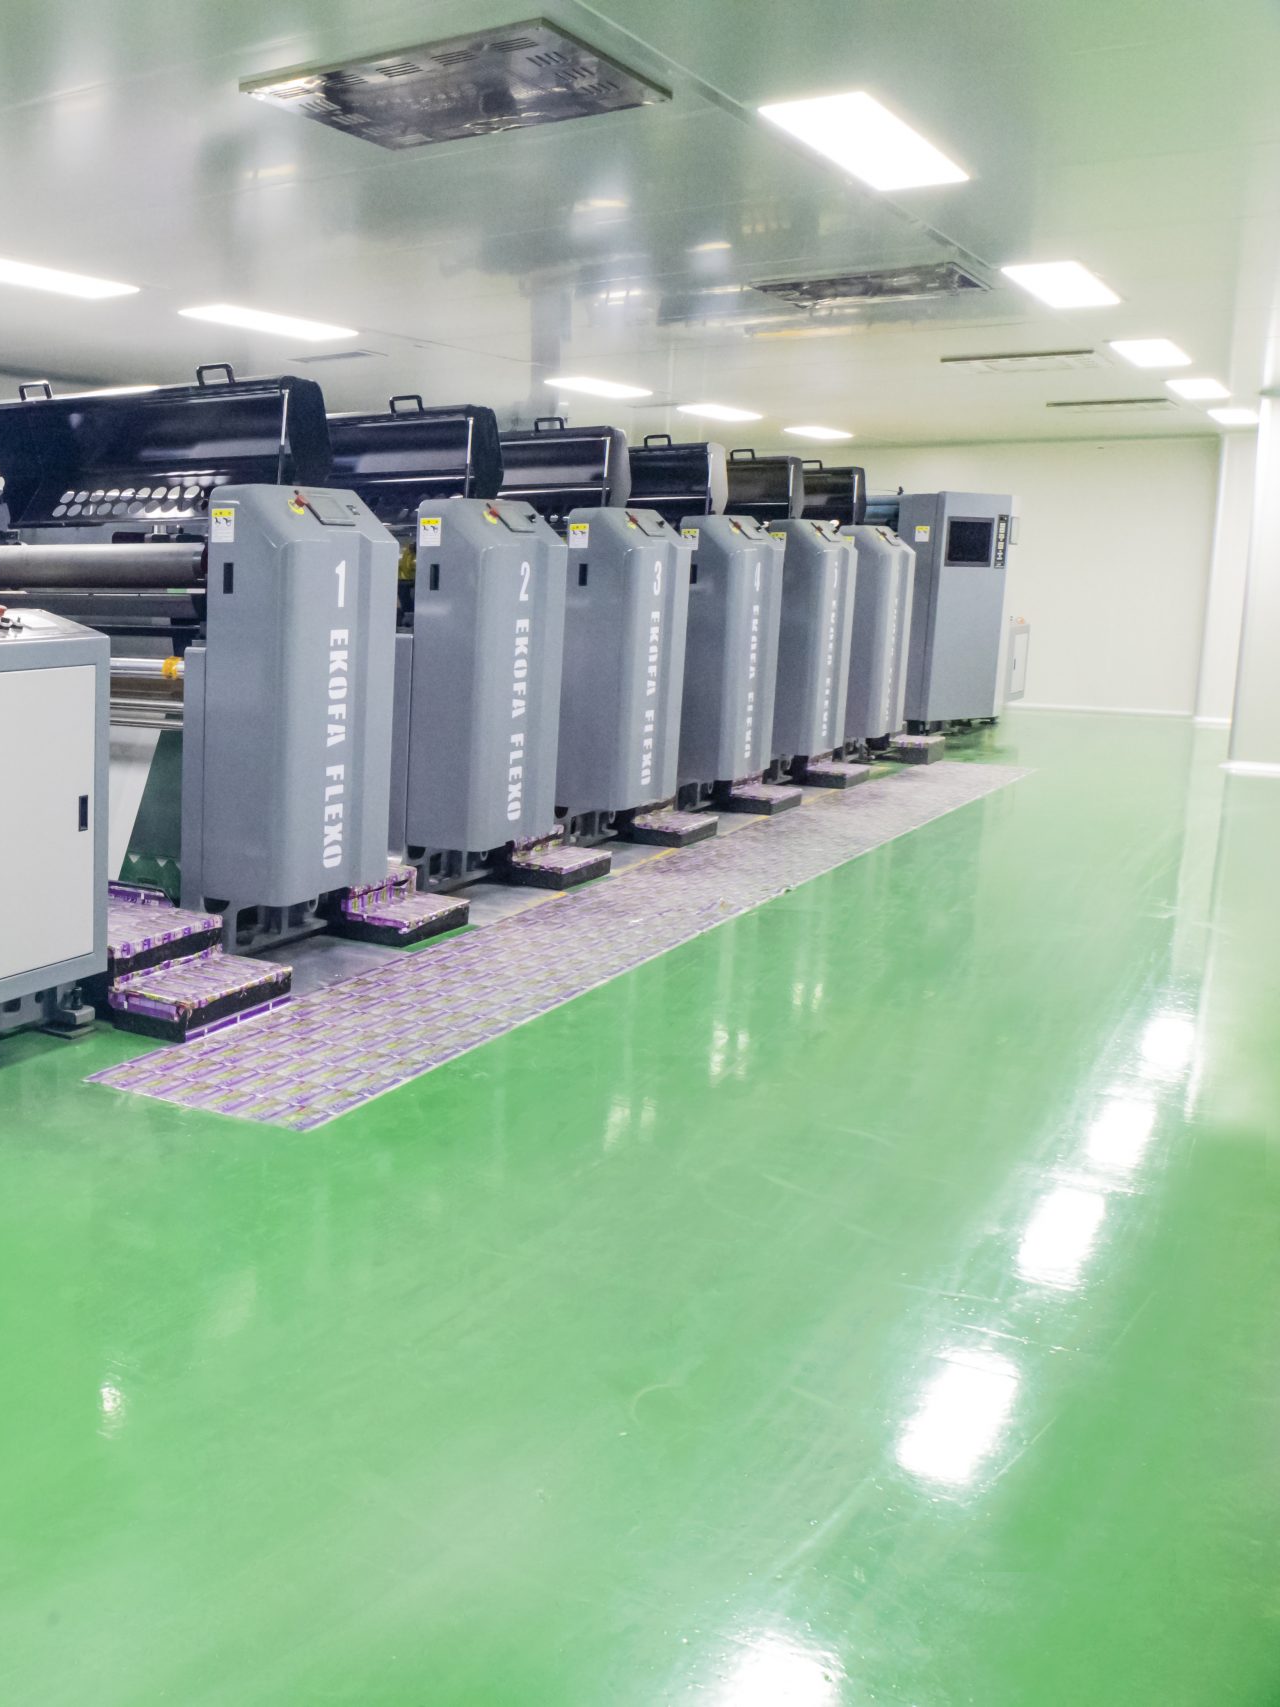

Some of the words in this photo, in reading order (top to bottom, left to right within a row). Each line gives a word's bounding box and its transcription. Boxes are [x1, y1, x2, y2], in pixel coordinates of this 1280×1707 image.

[335, 560, 346, 608] 1
[519, 561, 530, 601] 2
[653, 561, 662, 596] 3
[326, 628, 349, 747] EKOFA
[511, 618, 529, 719] EKOFA
[646, 611, 661, 697] EKOFA
[322, 764, 345, 869] FLEXO
[506, 732, 524, 821] FLEXO
